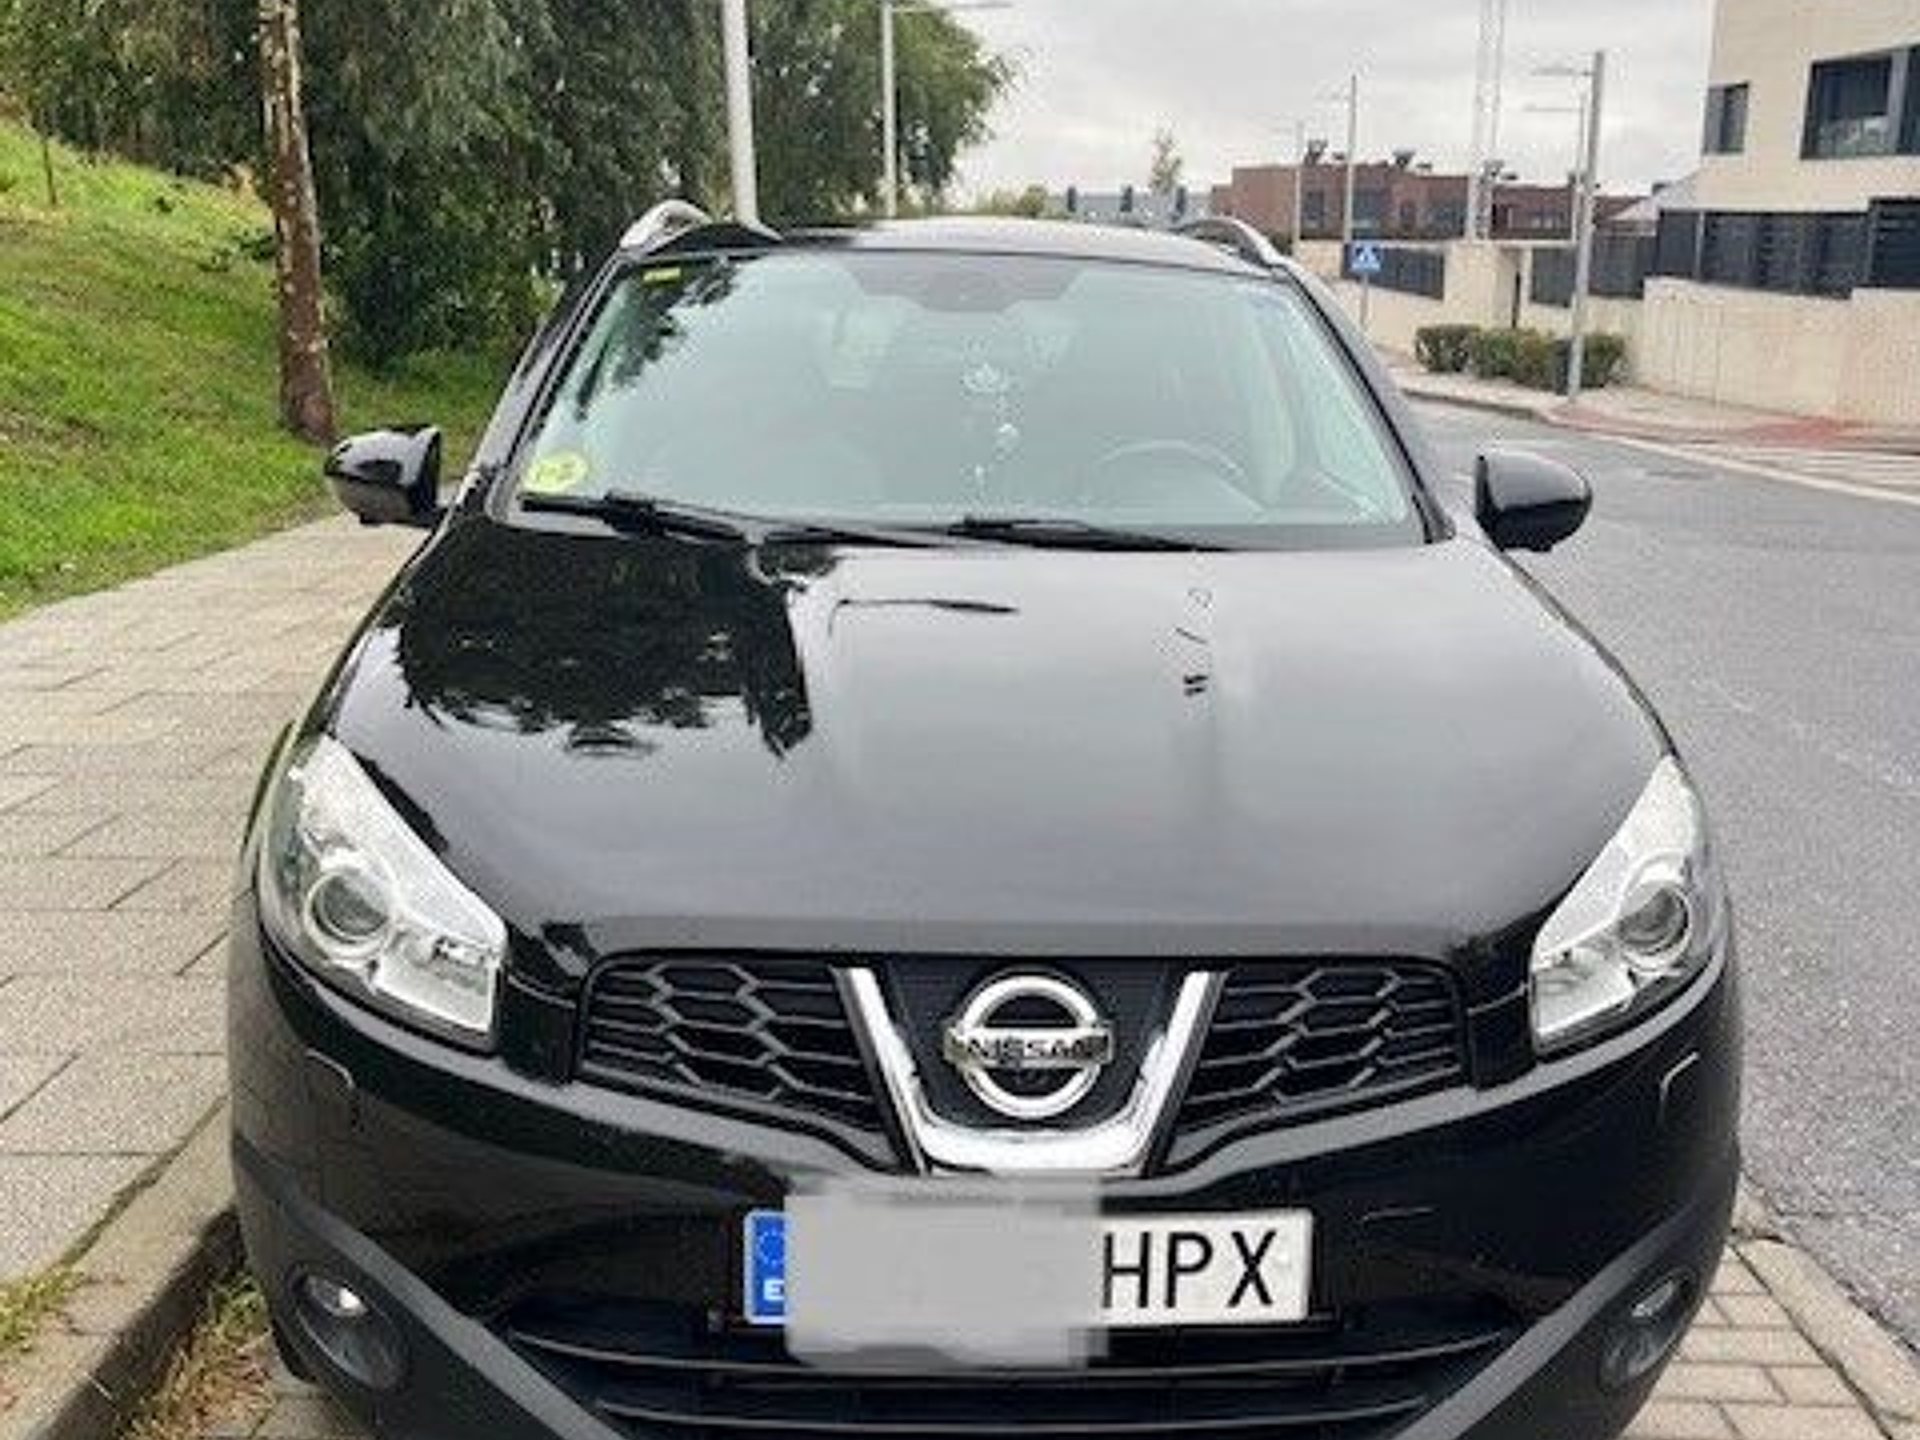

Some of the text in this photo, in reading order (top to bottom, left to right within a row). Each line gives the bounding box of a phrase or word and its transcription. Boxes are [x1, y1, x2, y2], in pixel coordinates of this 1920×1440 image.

[962, 1036, 1099, 1061] NISSAN
[1102, 1230, 1276, 1308] HPX
[764, 1279, 785, 1300] E
